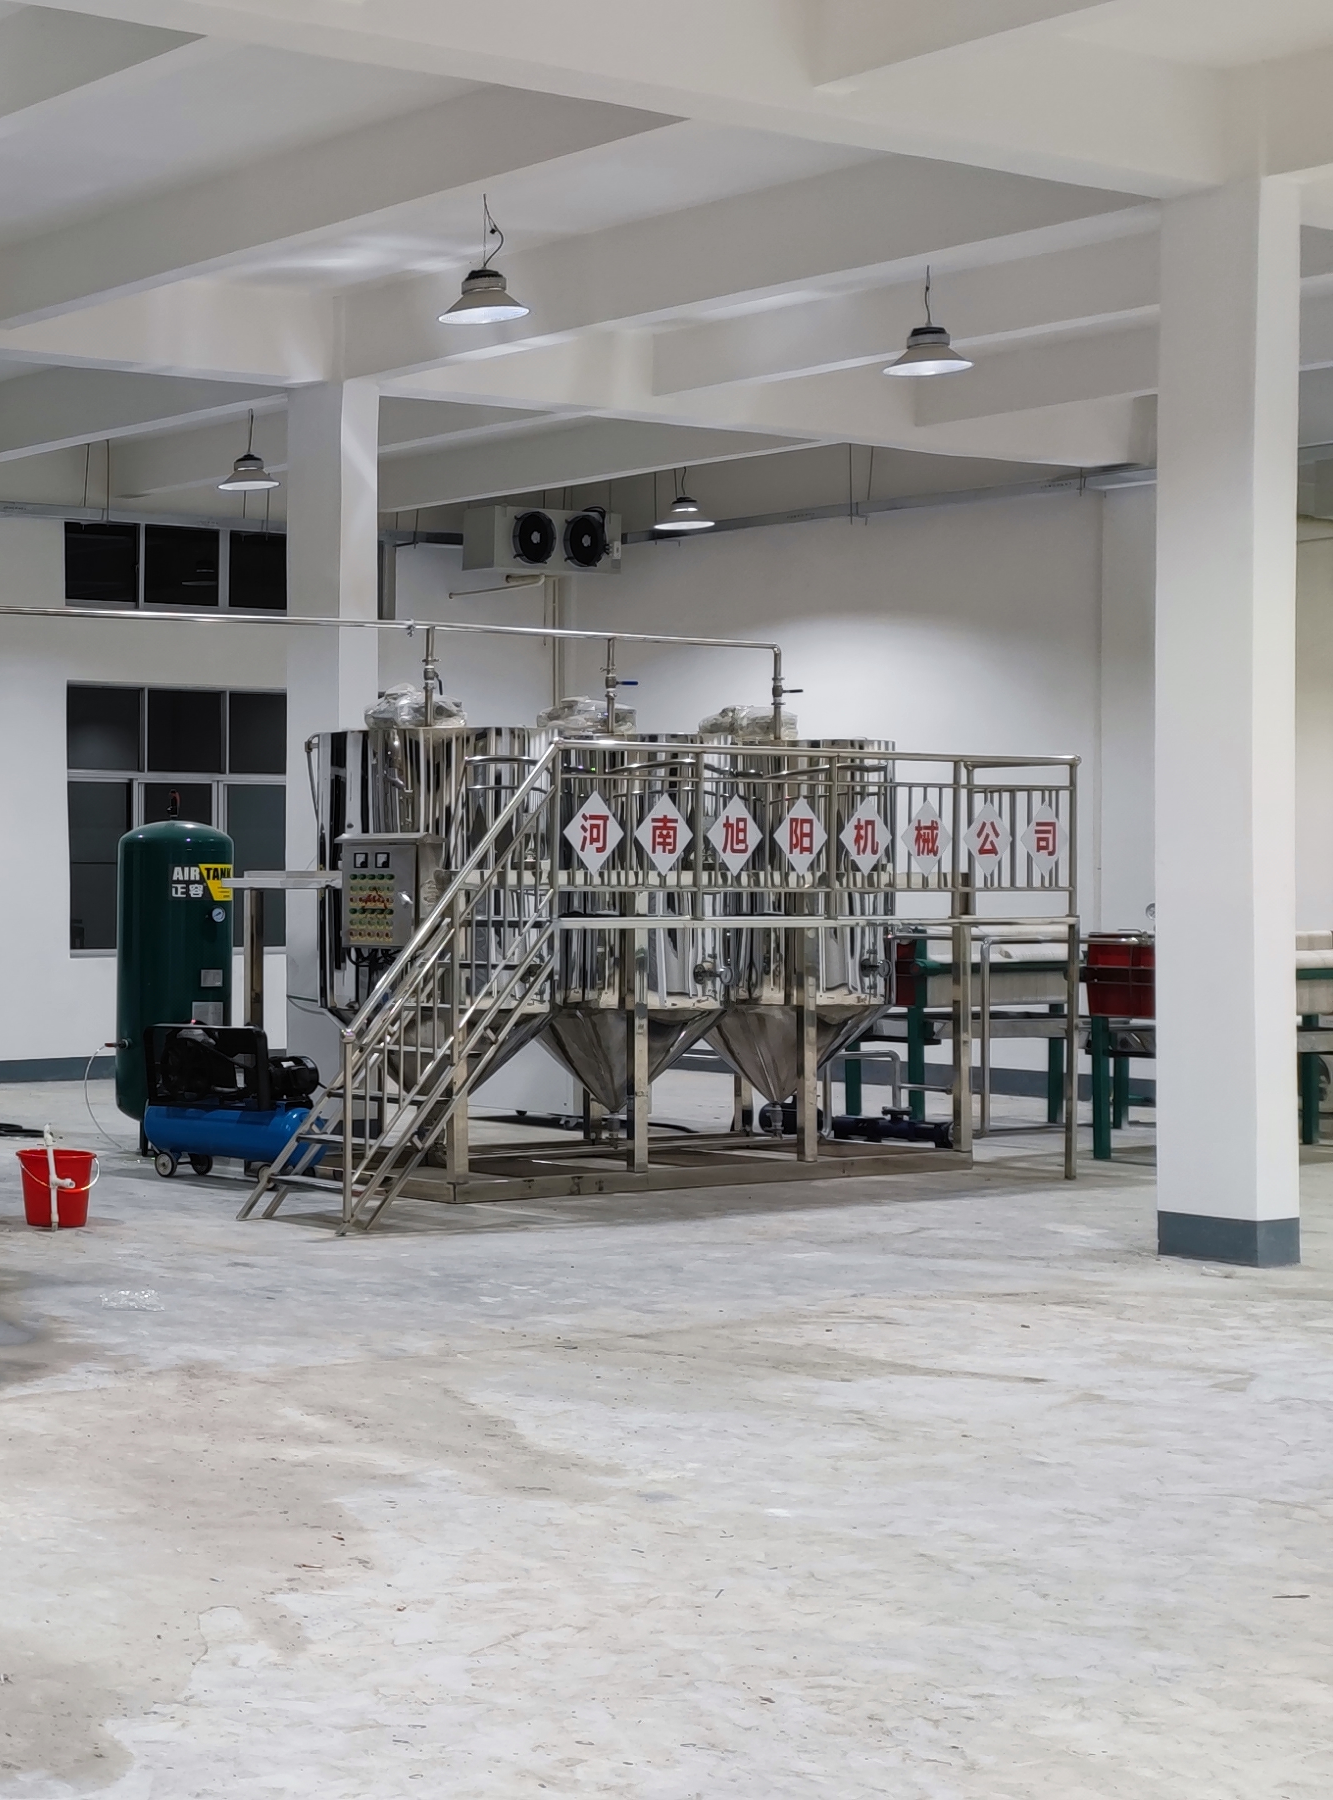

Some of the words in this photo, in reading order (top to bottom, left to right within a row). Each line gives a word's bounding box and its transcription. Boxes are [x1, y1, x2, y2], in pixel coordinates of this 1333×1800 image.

[172, 866, 200, 881] AIR
[204, 867, 232, 881] TANK
[171, 883, 204, 898] 正容
